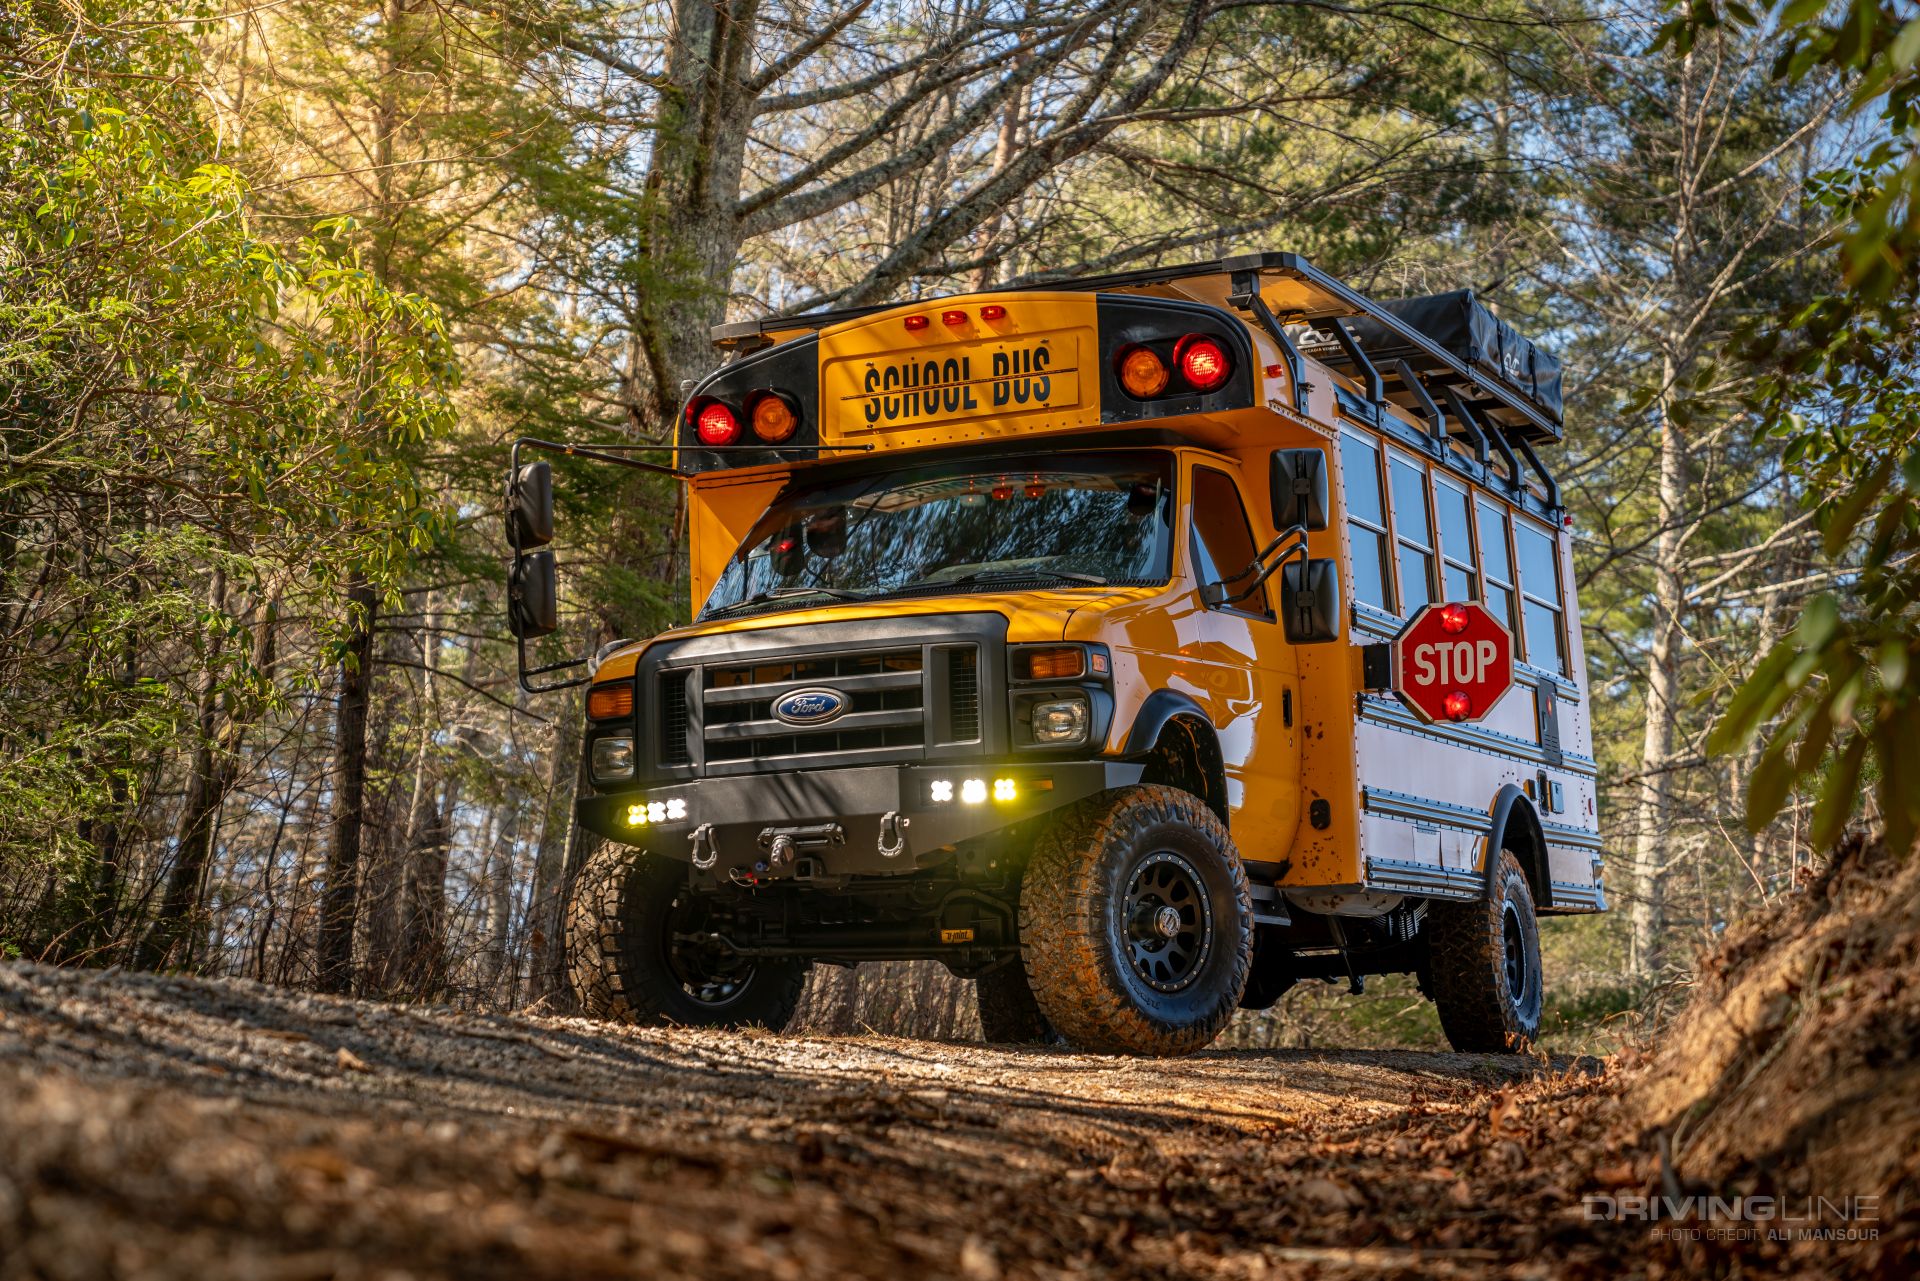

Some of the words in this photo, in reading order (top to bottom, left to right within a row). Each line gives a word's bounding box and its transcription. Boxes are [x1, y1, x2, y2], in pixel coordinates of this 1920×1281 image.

[864, 356, 978, 423] SCHOOL
[992, 346, 1050, 407] BUS
[1414, 639, 1497, 686] STOP
[791, 697, 825, 714] Ford
